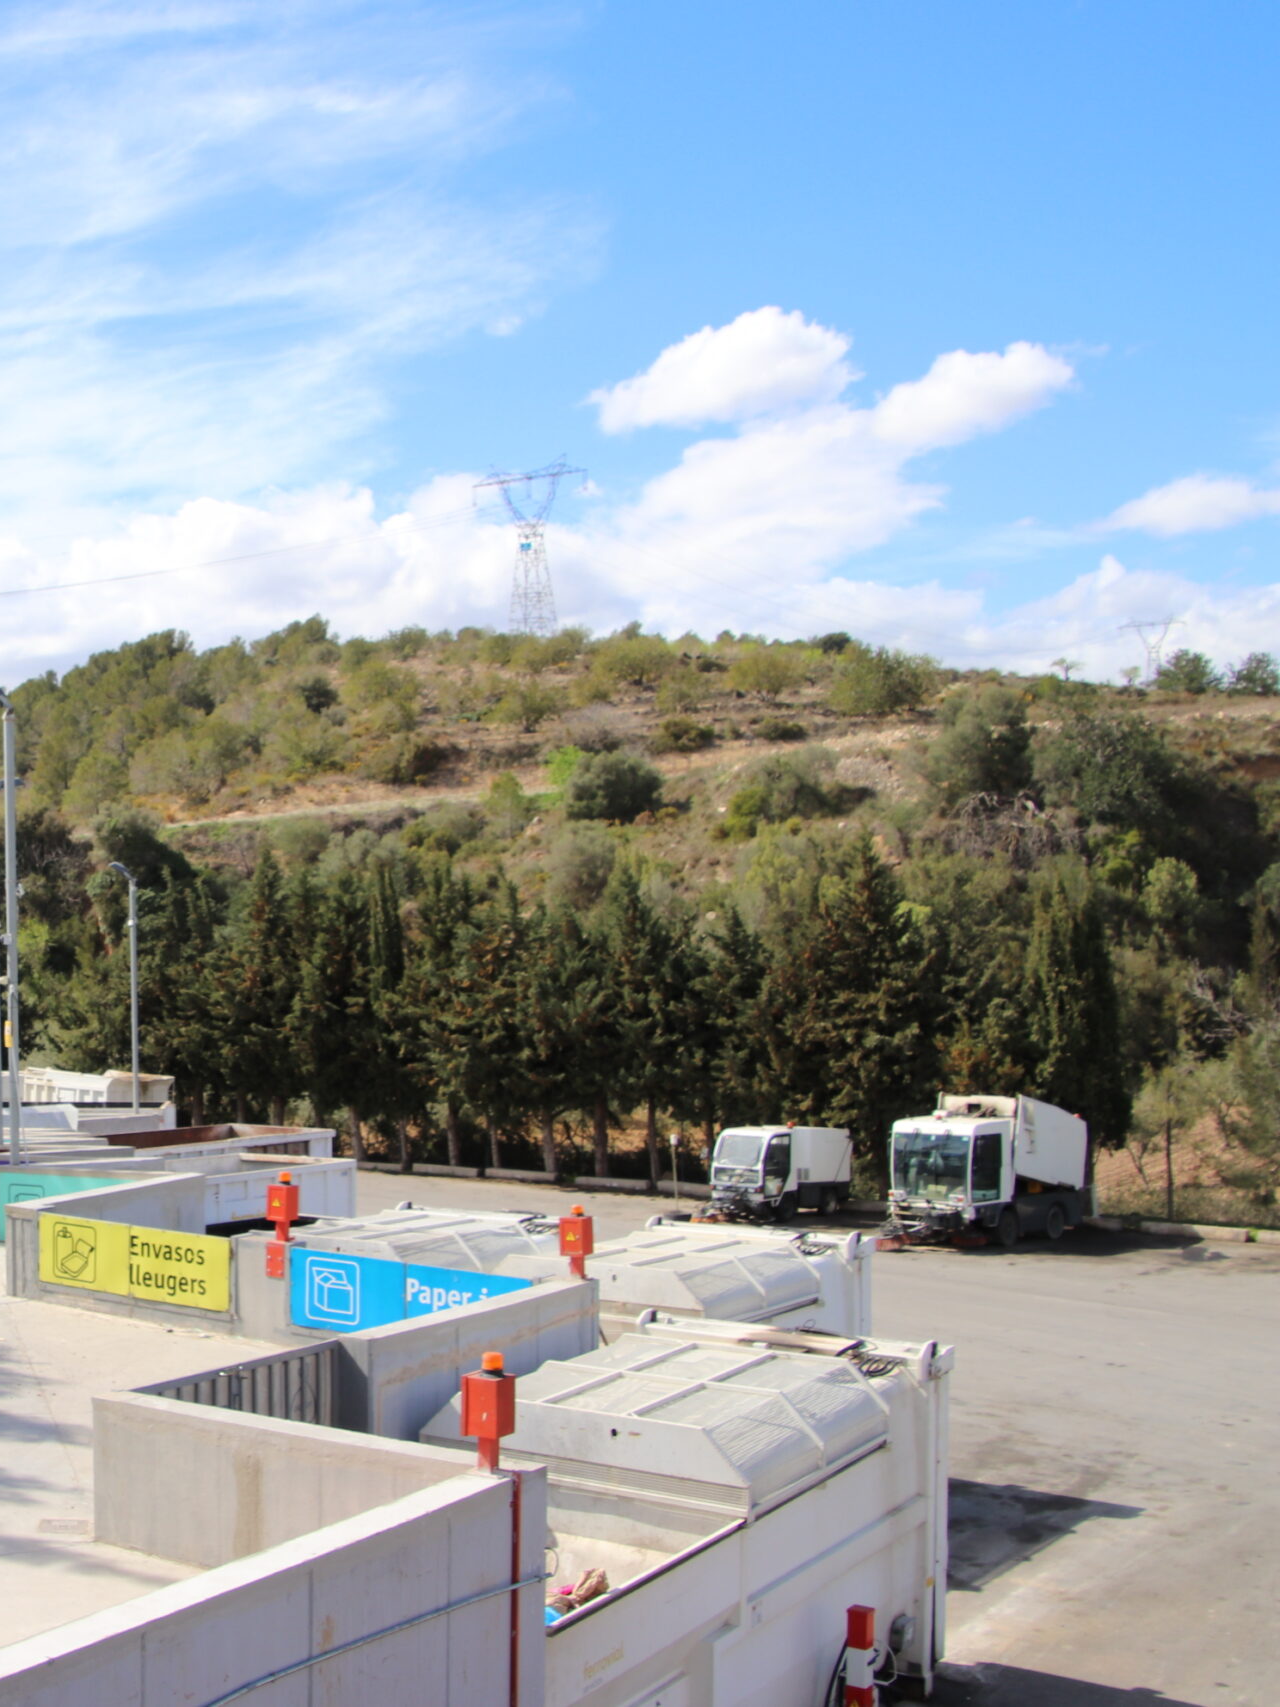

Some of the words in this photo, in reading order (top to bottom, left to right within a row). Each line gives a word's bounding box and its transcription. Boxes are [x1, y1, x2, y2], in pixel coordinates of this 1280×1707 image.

[130, 1235, 205, 1265] Envasos
[129, 1263, 206, 1296] lleugers
[406, 1278, 472, 1312] Paper
